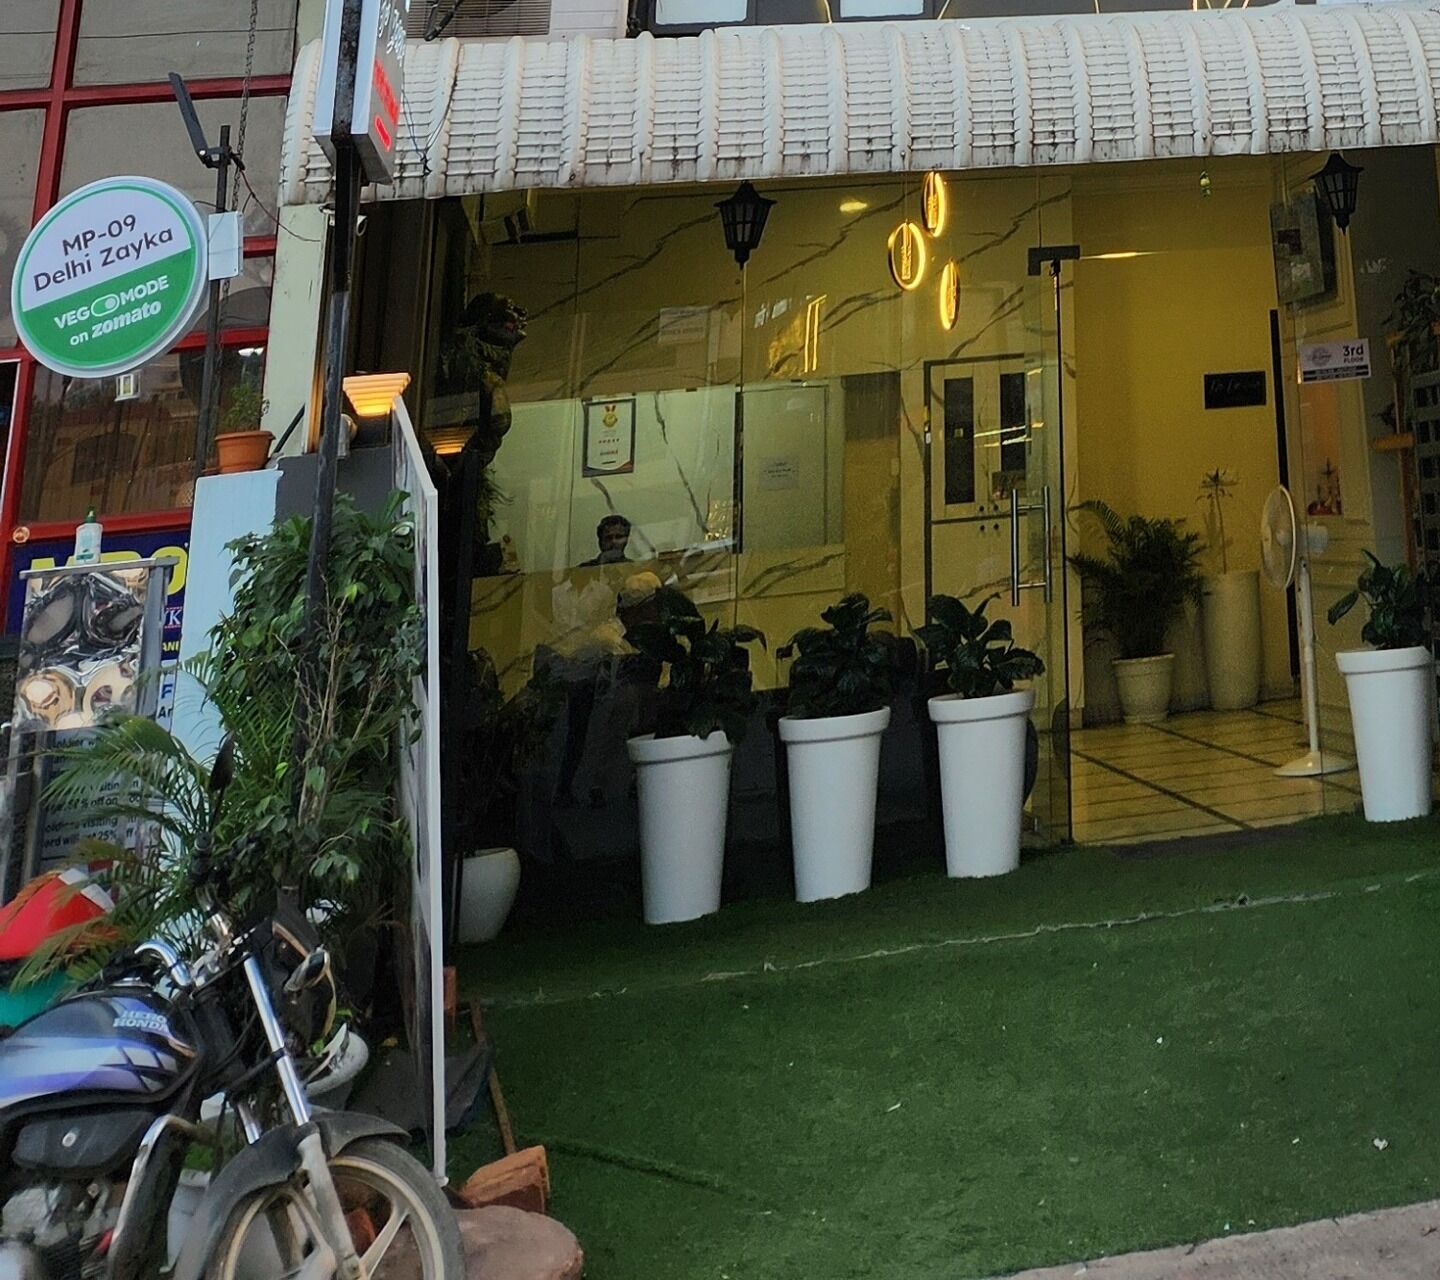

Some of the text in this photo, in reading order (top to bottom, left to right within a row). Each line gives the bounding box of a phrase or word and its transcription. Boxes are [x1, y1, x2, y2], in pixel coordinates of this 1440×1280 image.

[62, 214, 137, 257] MP-09
[33, 228, 174, 292] Delhi Zayka
[54, 275, 170, 329] VEG MODE
[69, 300, 162, 346] on zomato
[1343, 343, 1364, 357] 3rd
[112, 1018, 170, 1033] HONDA
